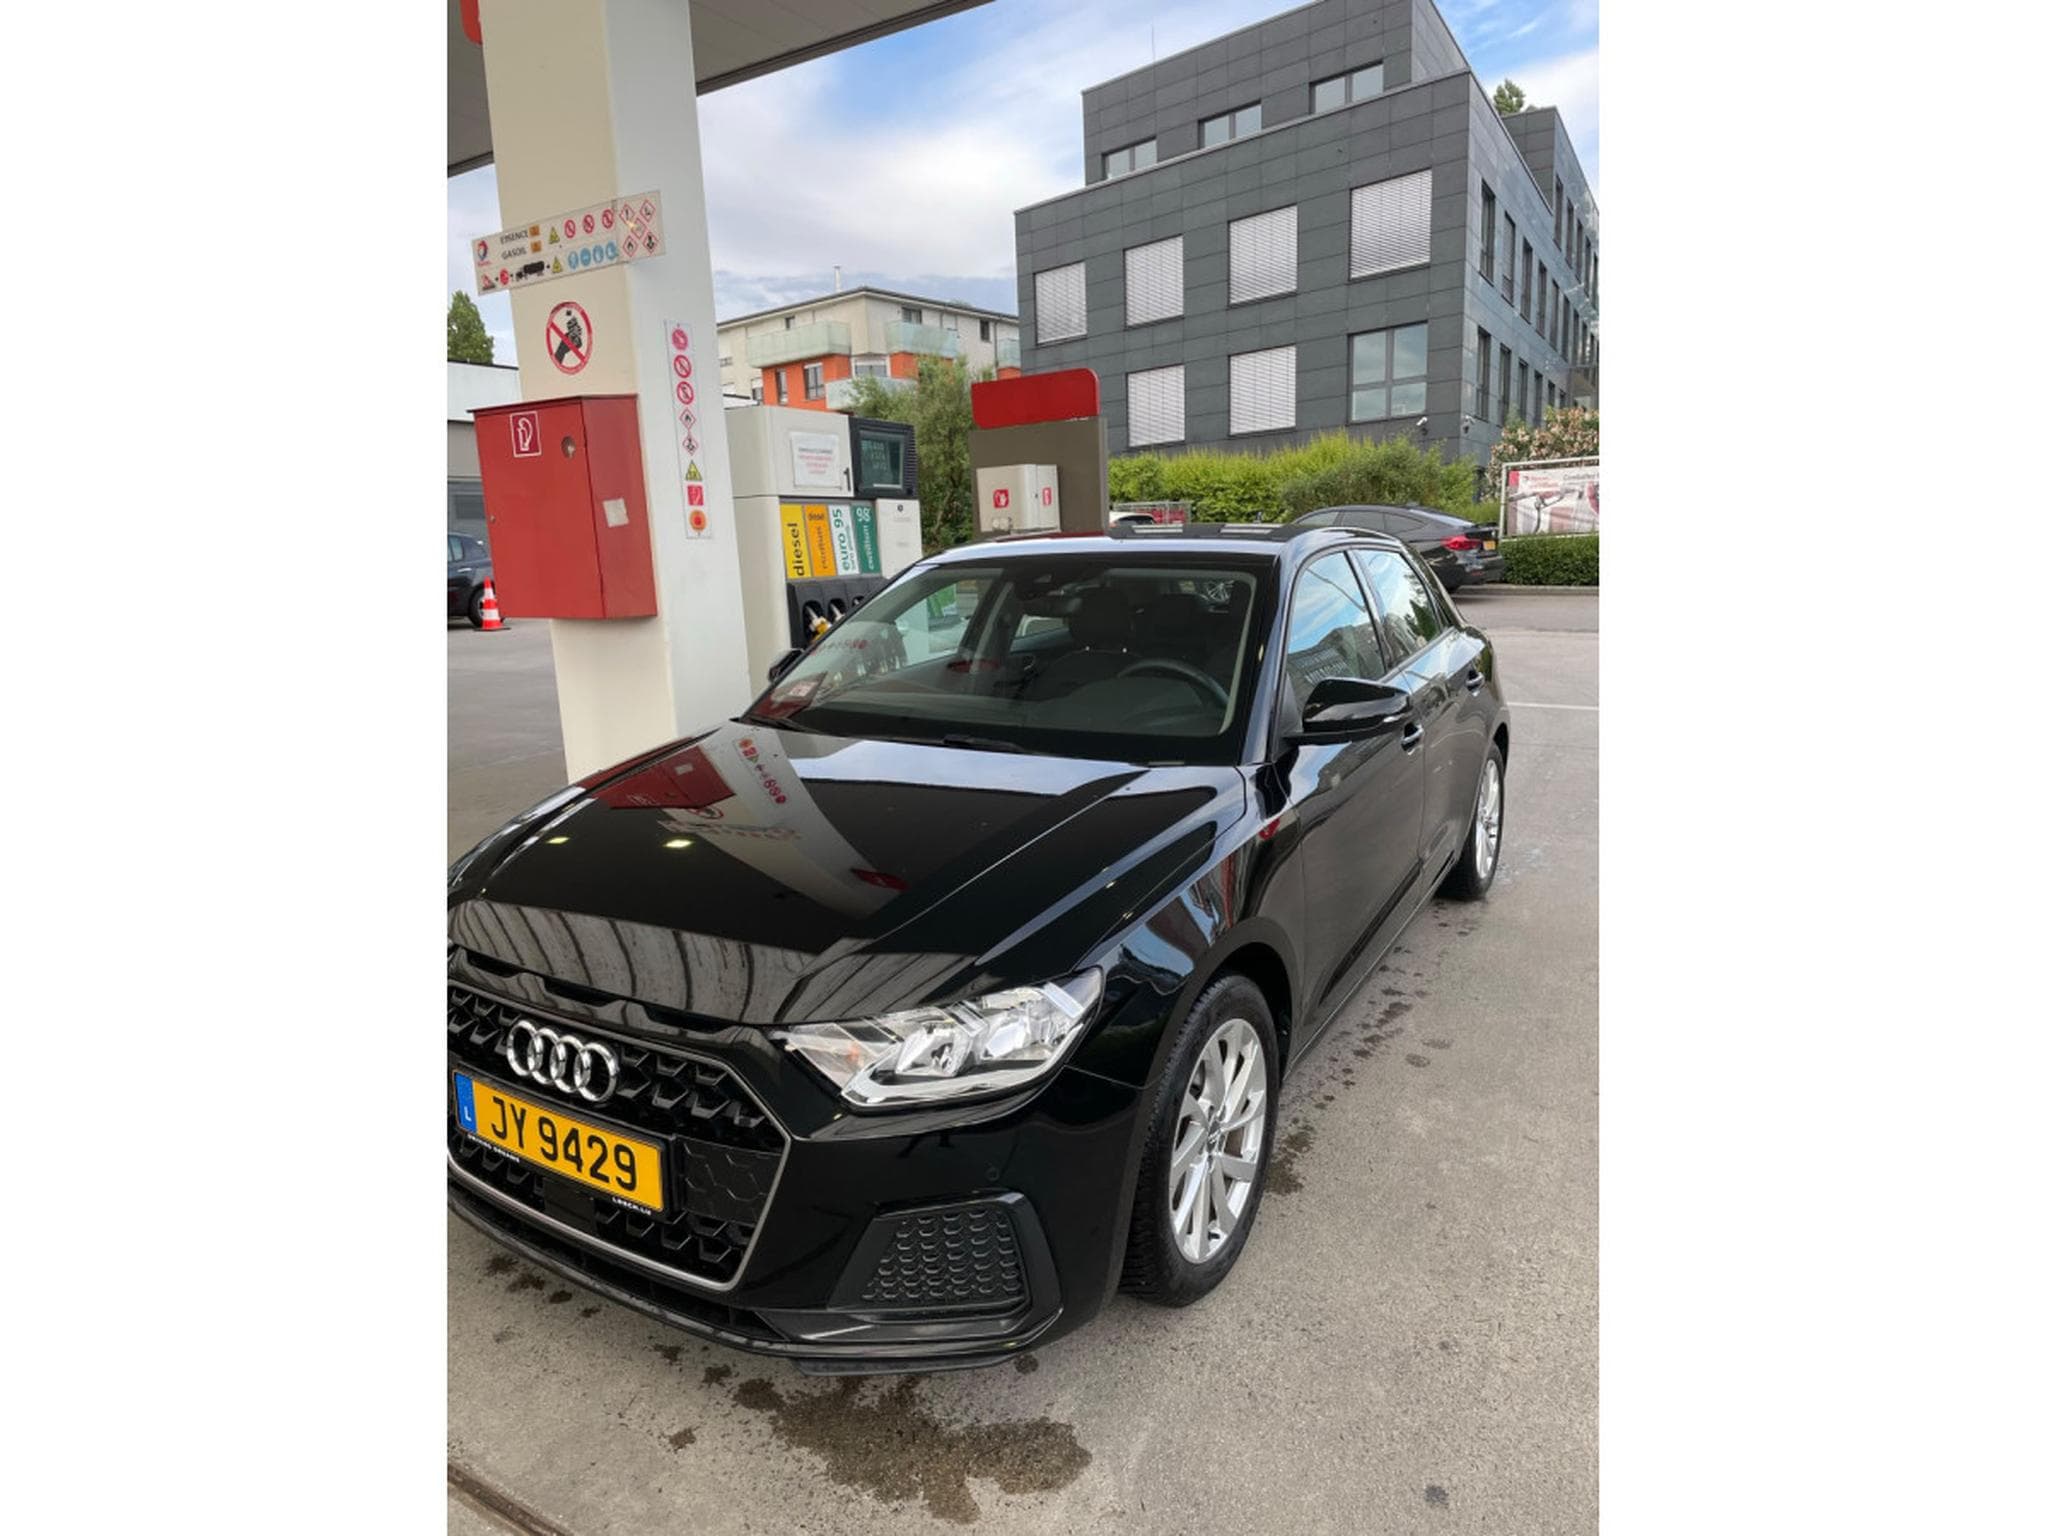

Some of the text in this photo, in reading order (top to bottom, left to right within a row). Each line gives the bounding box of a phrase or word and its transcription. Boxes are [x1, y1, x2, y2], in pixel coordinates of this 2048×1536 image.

[832, 508, 844, 528] 95
[856, 507, 872, 522] 98
[787, 522, 805, 577] diesel
[838, 533, 851, 571] euro
[464, 1105, 472, 1122] L
[491, 1095, 638, 1192] JY 9429
